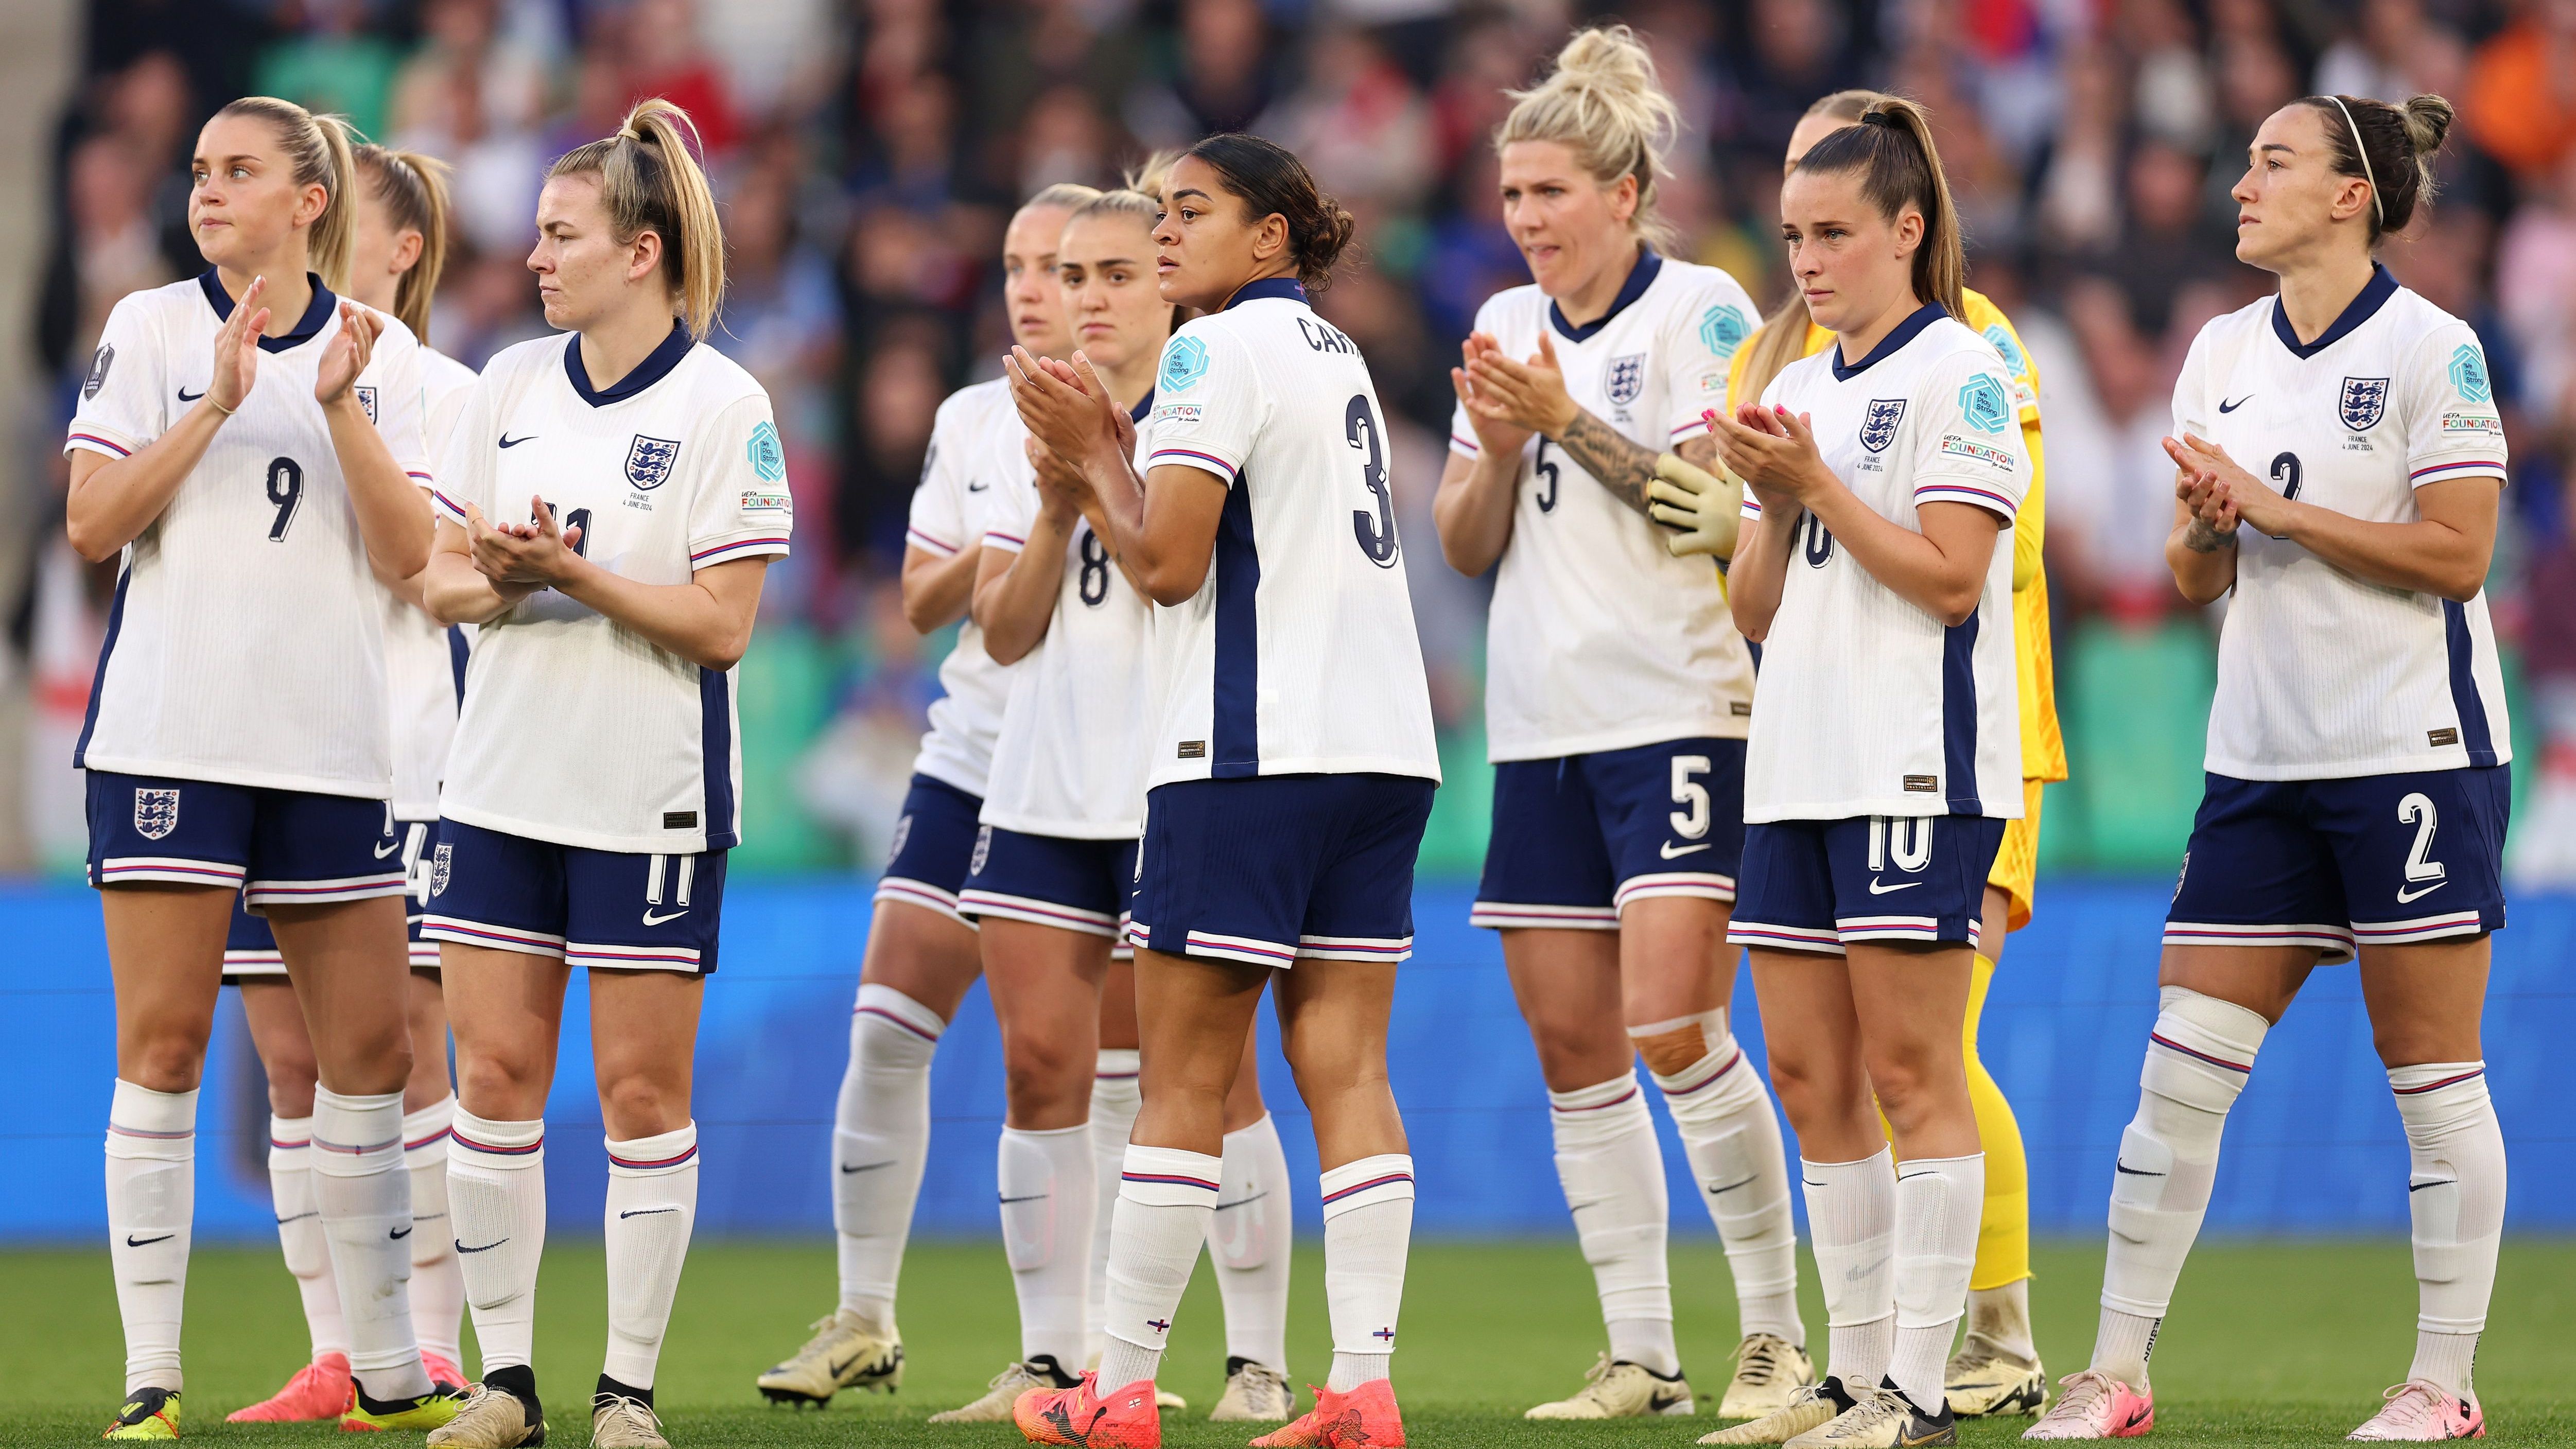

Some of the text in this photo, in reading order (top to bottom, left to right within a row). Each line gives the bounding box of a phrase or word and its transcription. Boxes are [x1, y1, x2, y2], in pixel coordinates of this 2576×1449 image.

[1296, 317, 1364, 368] CAR
[2465, 370, 2477, 378] Play
[2466, 377, 2483, 386] Strong
[1977, 397, 1991, 408] Play
[1976, 404, 1997, 417] Strong
[2443, 420, 2501, 429] FOUNDATION
[762, 447, 773, 456] Play
[1942, 441, 2014, 466] FOUNDATION
[763, 455, 778, 464] Strong
[1537, 434, 1559, 514] 5
[1998, 465, 2013, 473] children
[1346, 394, 1399, 568] 3
[266, 457, 304, 543] 9
[630, 492, 649, 502] FRANCE
[627, 500, 639, 509] JUNE
[742, 498, 792, 509] FOUNDATION
[1081, 528, 1111, 607] 8
[1669, 755, 1711, 840] 5
[2397, 792, 2446, 882] 2
[1868, 815, 1934, 873] 10
